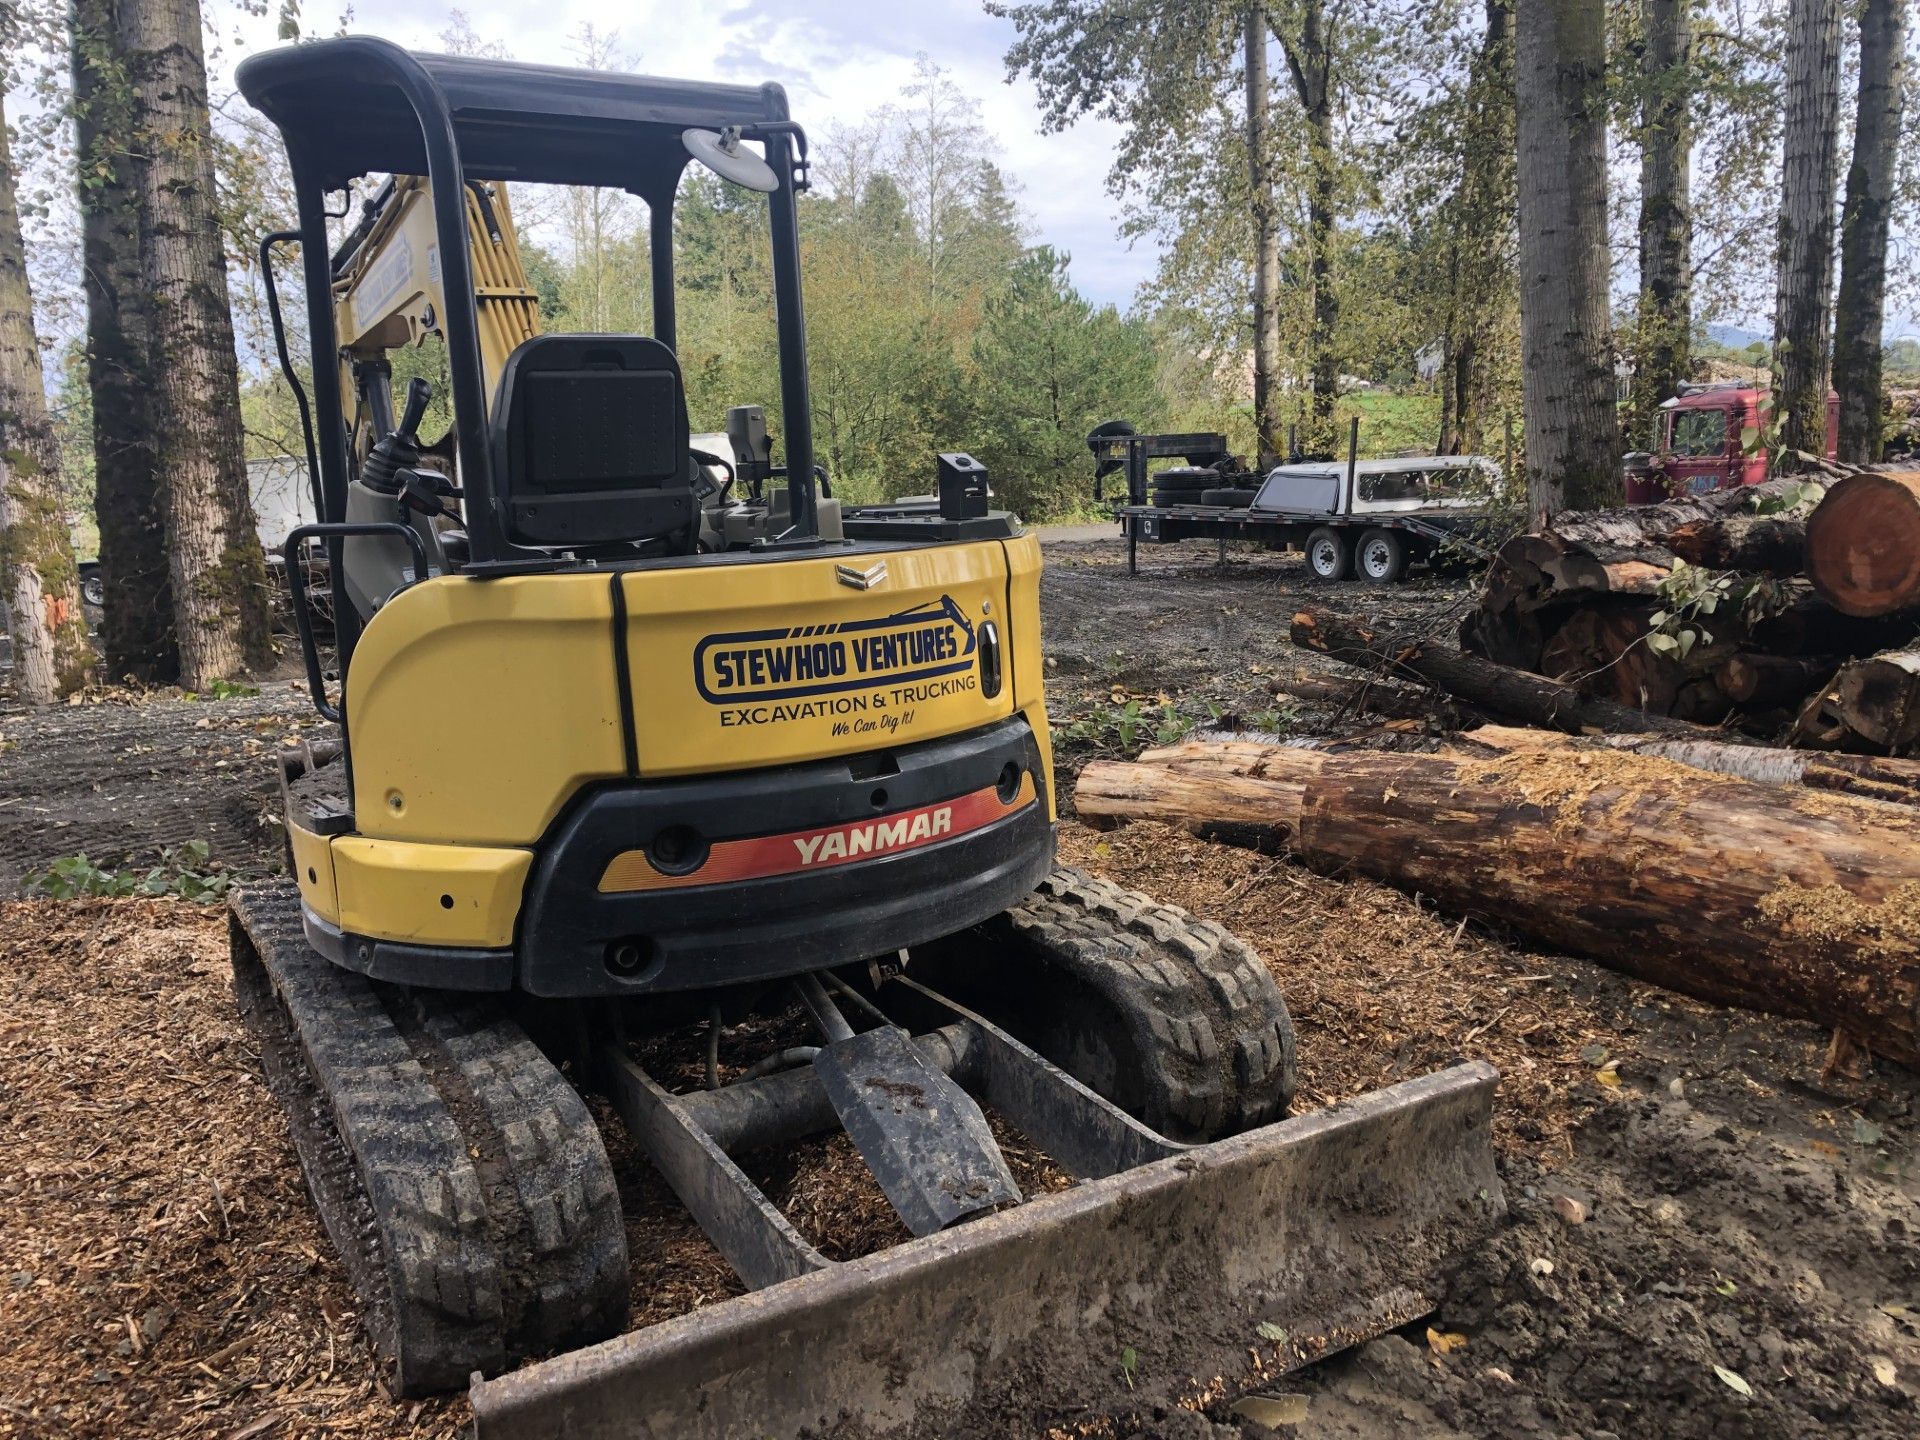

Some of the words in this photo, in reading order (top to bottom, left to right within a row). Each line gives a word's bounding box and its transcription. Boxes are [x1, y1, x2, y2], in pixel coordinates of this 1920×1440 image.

[714, 640, 846, 688] STEWHOO
[852, 625, 957, 672] VENTURES
[720, 696, 867, 726] EXCAVATION
[873, 693, 887, 708] &
[890, 675, 976, 704] TRUCKING
[831, 722, 850, 737] We
[853, 718, 877, 733] Can
[879, 715, 899, 734] Dig
[901, 709, 916, 727] It!
[793, 807, 952, 864] YANMAR
